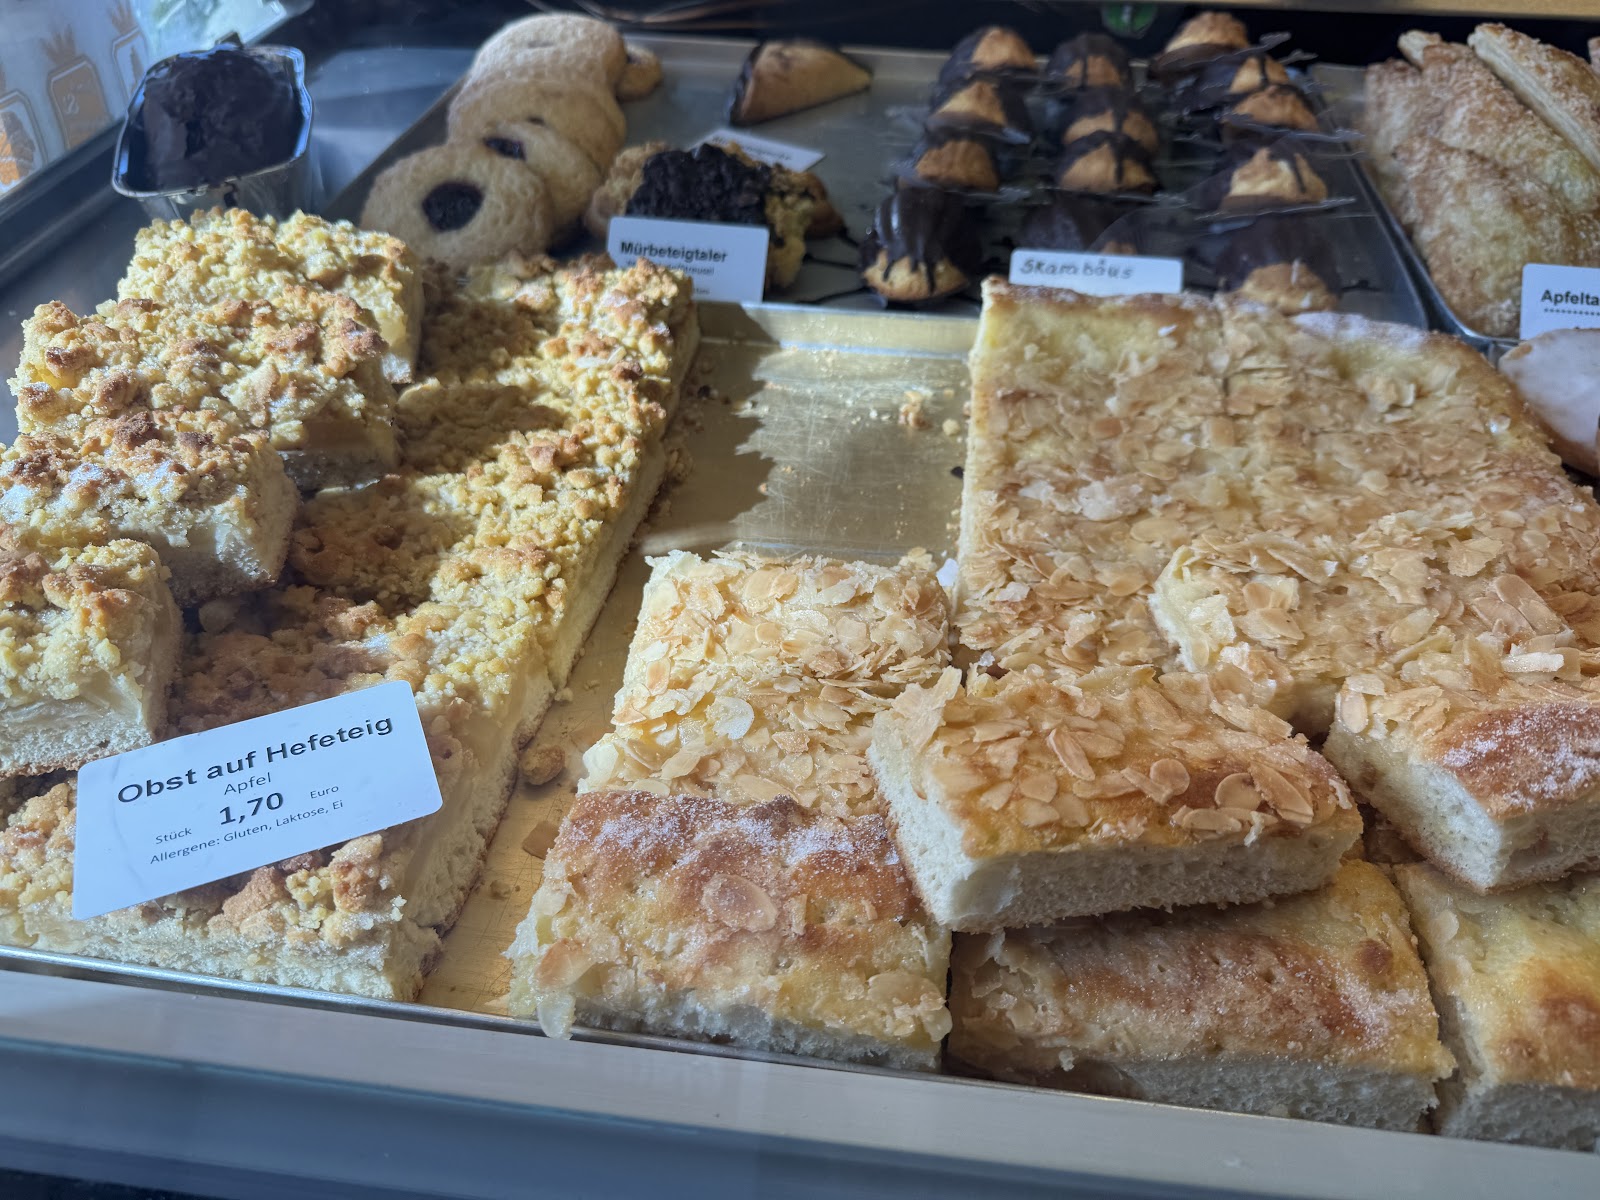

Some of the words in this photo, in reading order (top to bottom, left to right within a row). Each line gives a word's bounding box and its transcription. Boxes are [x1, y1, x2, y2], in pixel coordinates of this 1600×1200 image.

[620, 241, 728, 264] Mürbeteigtaler
[1541, 289, 1599, 306] Apfelta
[117, 768, 198, 803] Obst
[206, 750, 257, 780] auf
[266, 717, 393, 763] Hefeteig
[223, 772, 271, 796] Apfel
[150, 837, 221, 865] Allergene:
[223, 823, 272, 842] Gluten,
[275, 805, 329, 827] Laktose,
[332, 799, 344, 810] Ei
[155, 827, 193, 845] Stück
[219, 792, 284, 826] 1,70
[310, 785, 340, 799] Euro
